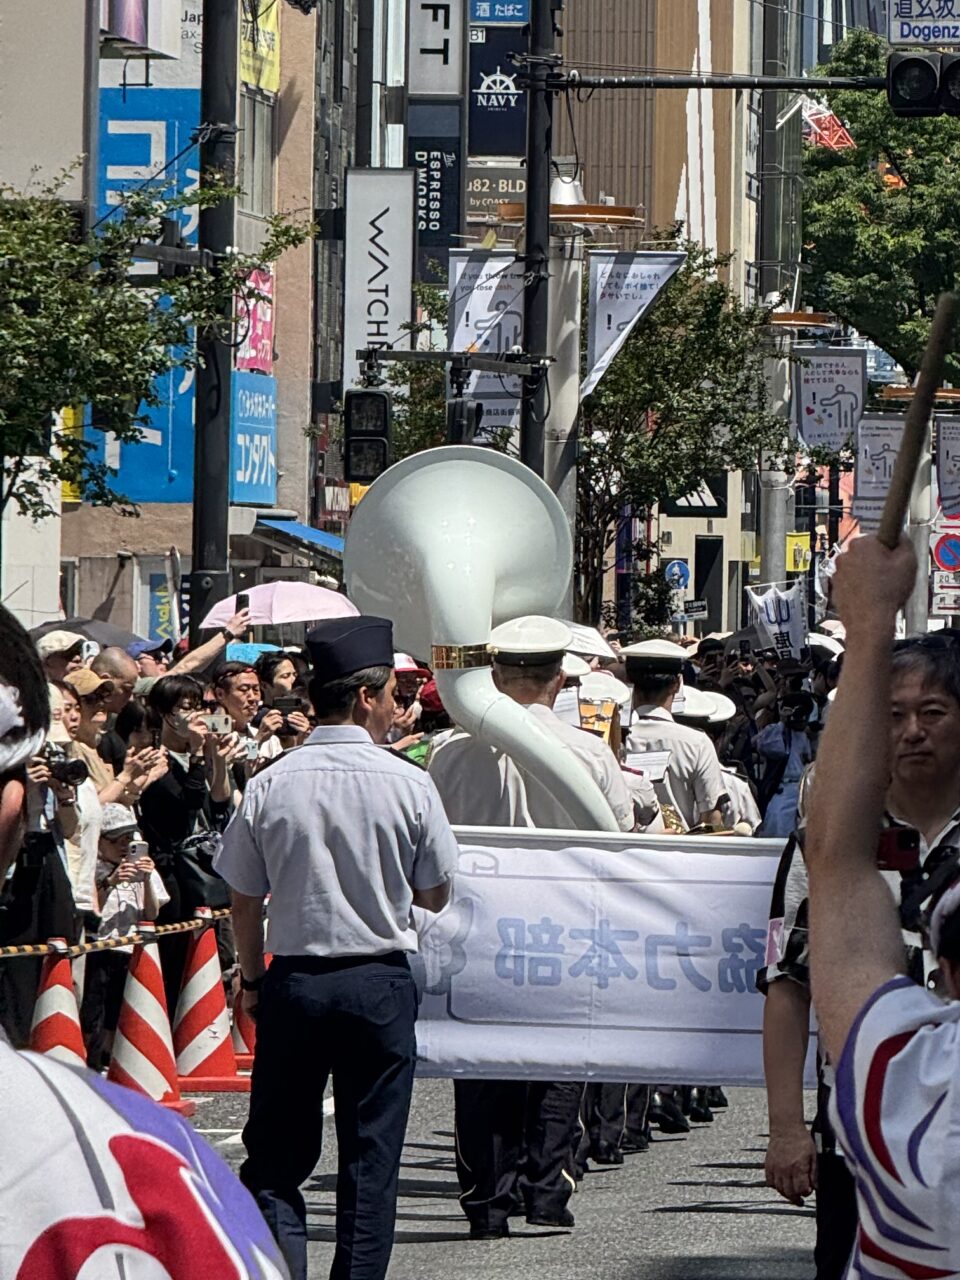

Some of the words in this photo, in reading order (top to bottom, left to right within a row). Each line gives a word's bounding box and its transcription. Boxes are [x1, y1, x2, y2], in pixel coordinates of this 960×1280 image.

[475, 2, 491, 17] 酒
[494, 4, 524, 17] たばこ
[470, 30, 485, 42] B1
[477, 94, 518, 107] NAVY
[429, 151, 441, 231] ESPRESSO
[469, 197, 481, 206] by
[367, 206, 390, 350] WATCH
[236, 432, 275, 487] コンタクト
